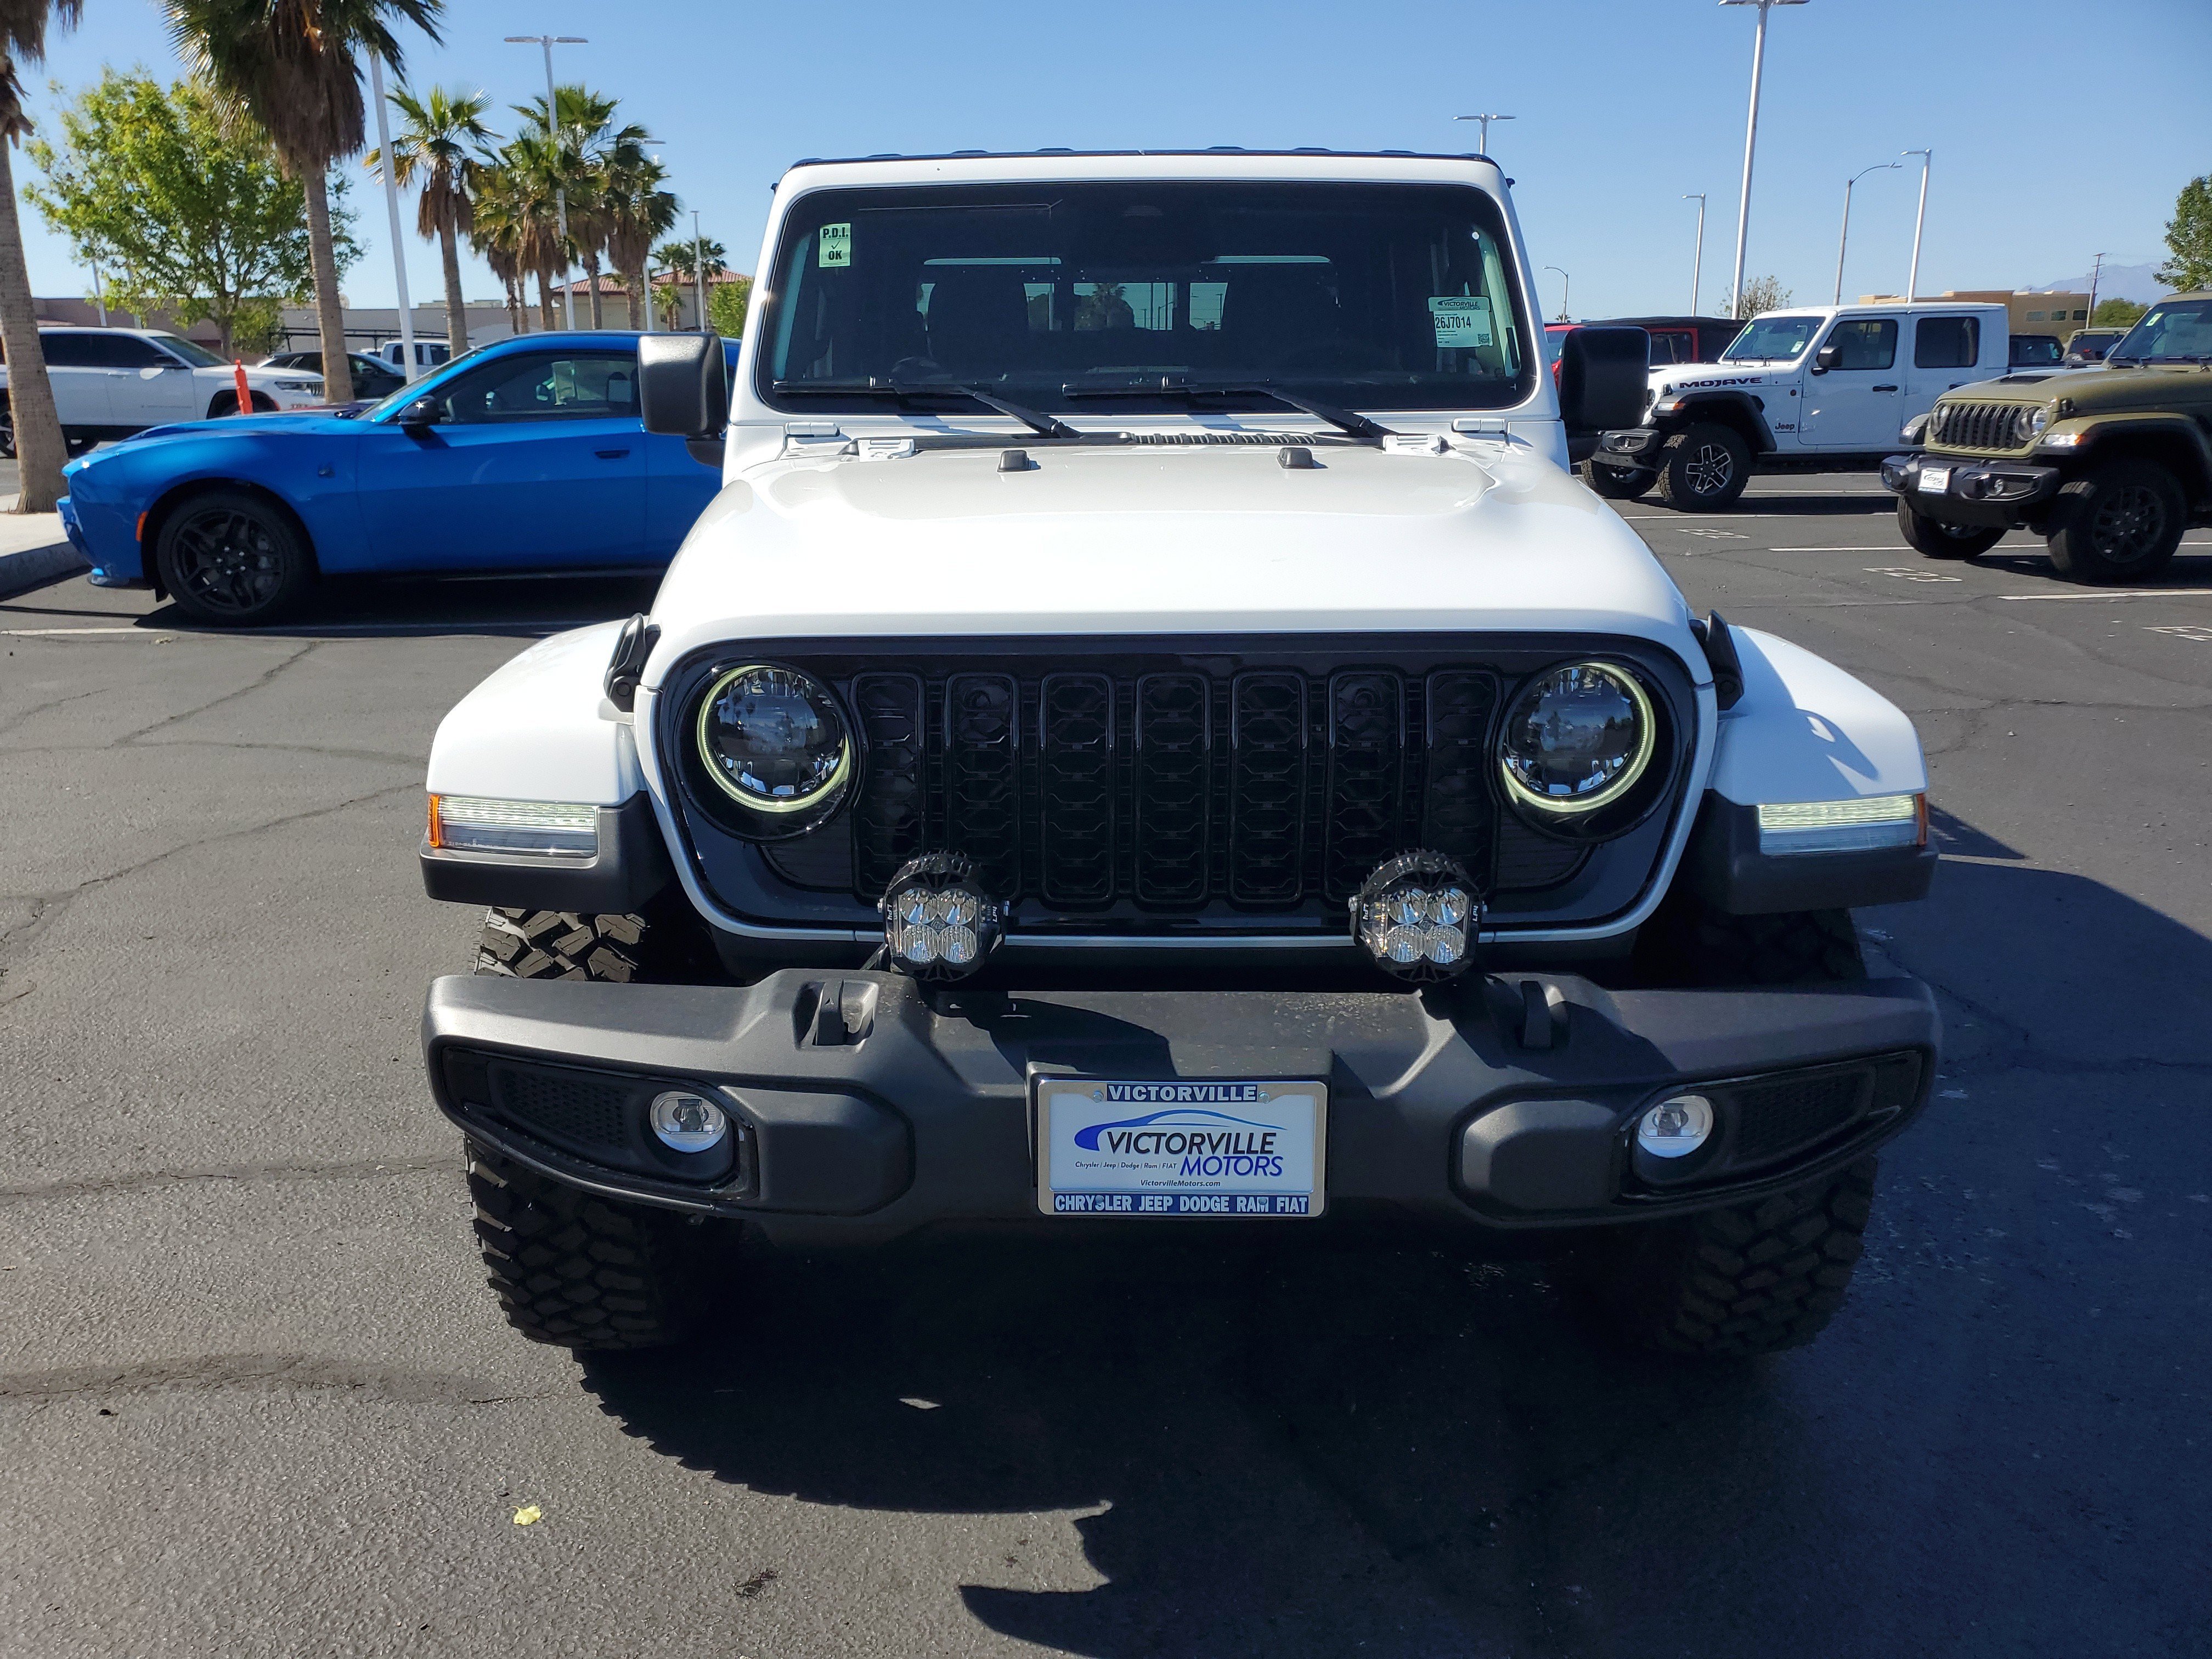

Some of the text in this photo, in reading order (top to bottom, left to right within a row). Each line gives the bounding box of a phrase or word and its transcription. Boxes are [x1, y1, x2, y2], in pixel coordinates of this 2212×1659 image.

[823, 227, 849, 239] P.D.I.
[828, 250, 843, 260] OK
[1435, 316, 1471, 329] 26J7014
[1679, 377, 1763, 389] MOJAVE
[1775, 422, 1796, 431] Jeep
[1108, 1085, 1256, 1102] VICTORVILLE
[1107, 1131, 1277, 1155] VICTORVILLE
[1075, 1161, 1099, 1169] Chrysler
[1103, 1161, 1116, 1170] Jeep
[1179, 1155, 1284, 1177] MOTORS
[1141, 1179, 1221, 1187] VictorvilleMotors.com
[1055, 1195, 1307, 1213] CHRYSLER JEEP DODGE RAM FIAT
